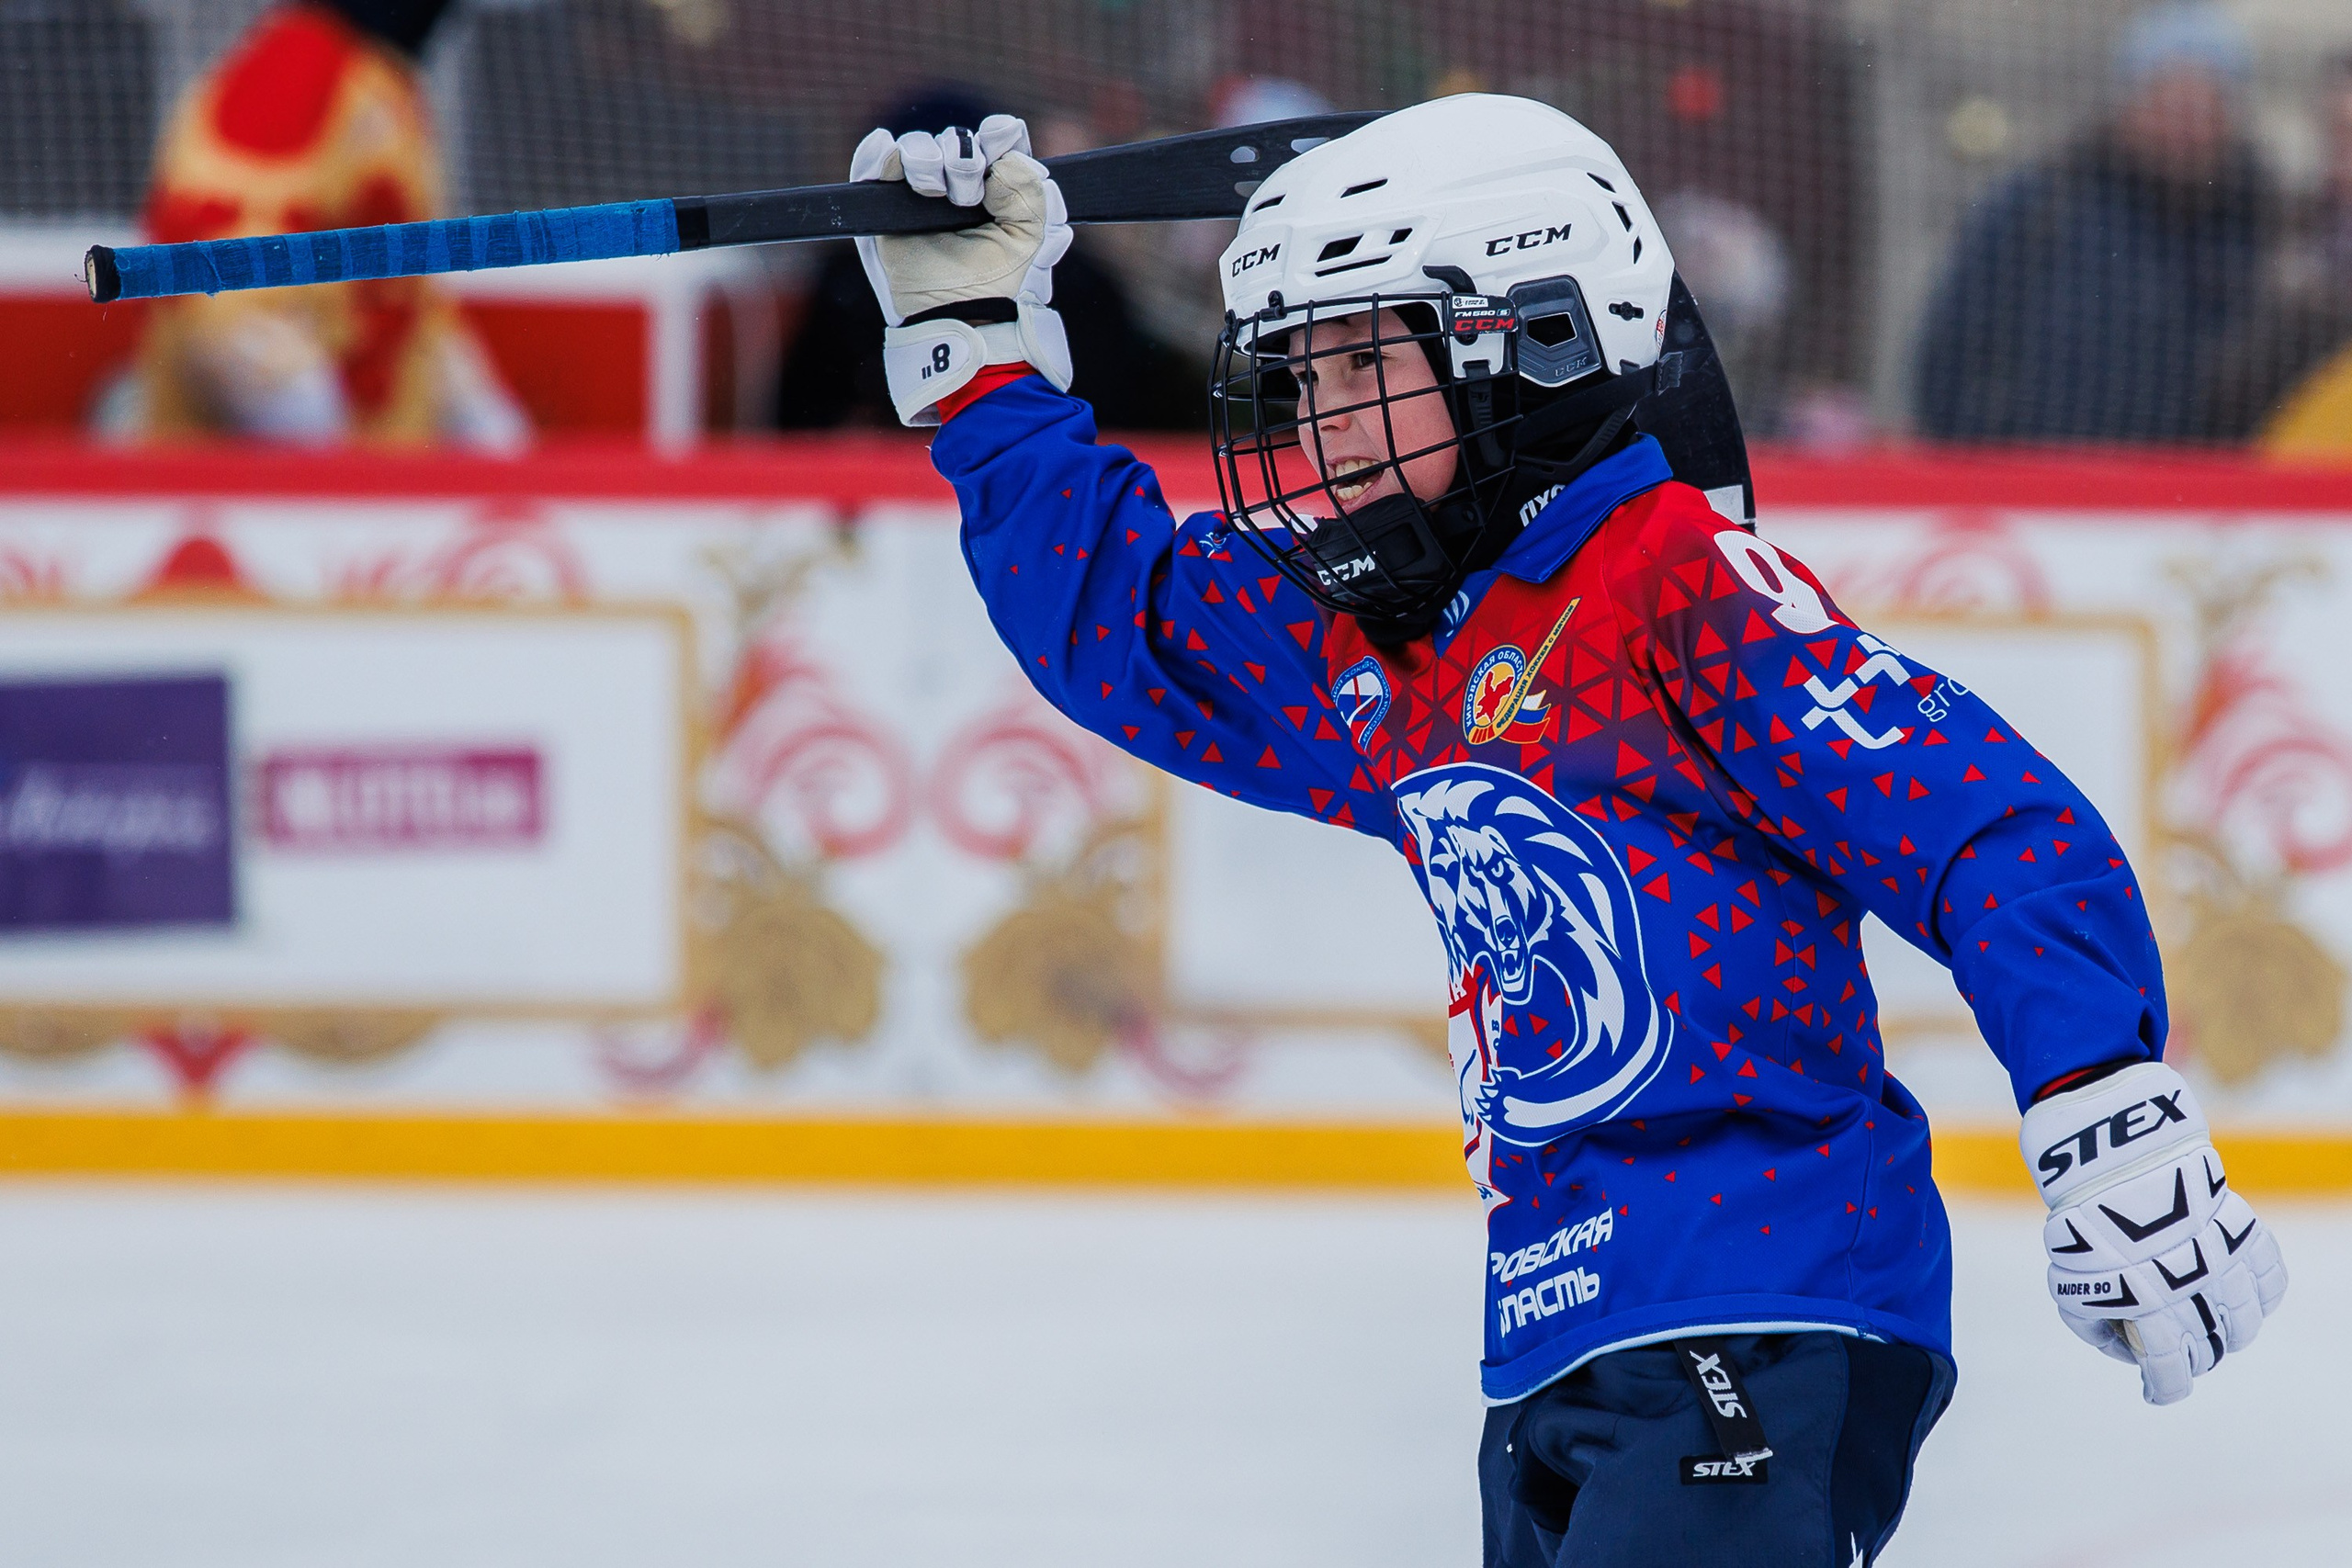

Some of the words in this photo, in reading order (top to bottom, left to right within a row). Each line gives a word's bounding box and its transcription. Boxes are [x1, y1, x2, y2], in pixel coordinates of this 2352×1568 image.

[1485, 223, 1572, 256] CCM
[1232, 243, 1281, 277] CCM
[1454, 319, 1515, 332] CCM
[1317, 555, 1375, 586] CCM
[1465, 655, 1495, 728] КИРОВСКАЯ
[2038, 1089, 2188, 1188] STEX
[2057, 1283, 2090, 1295] RAIDER
[2094, 1281, 2111, 1293] 90
[1690, 1350, 1747, 1417] STEX
[1693, 1461, 1756, 1477] STEX
